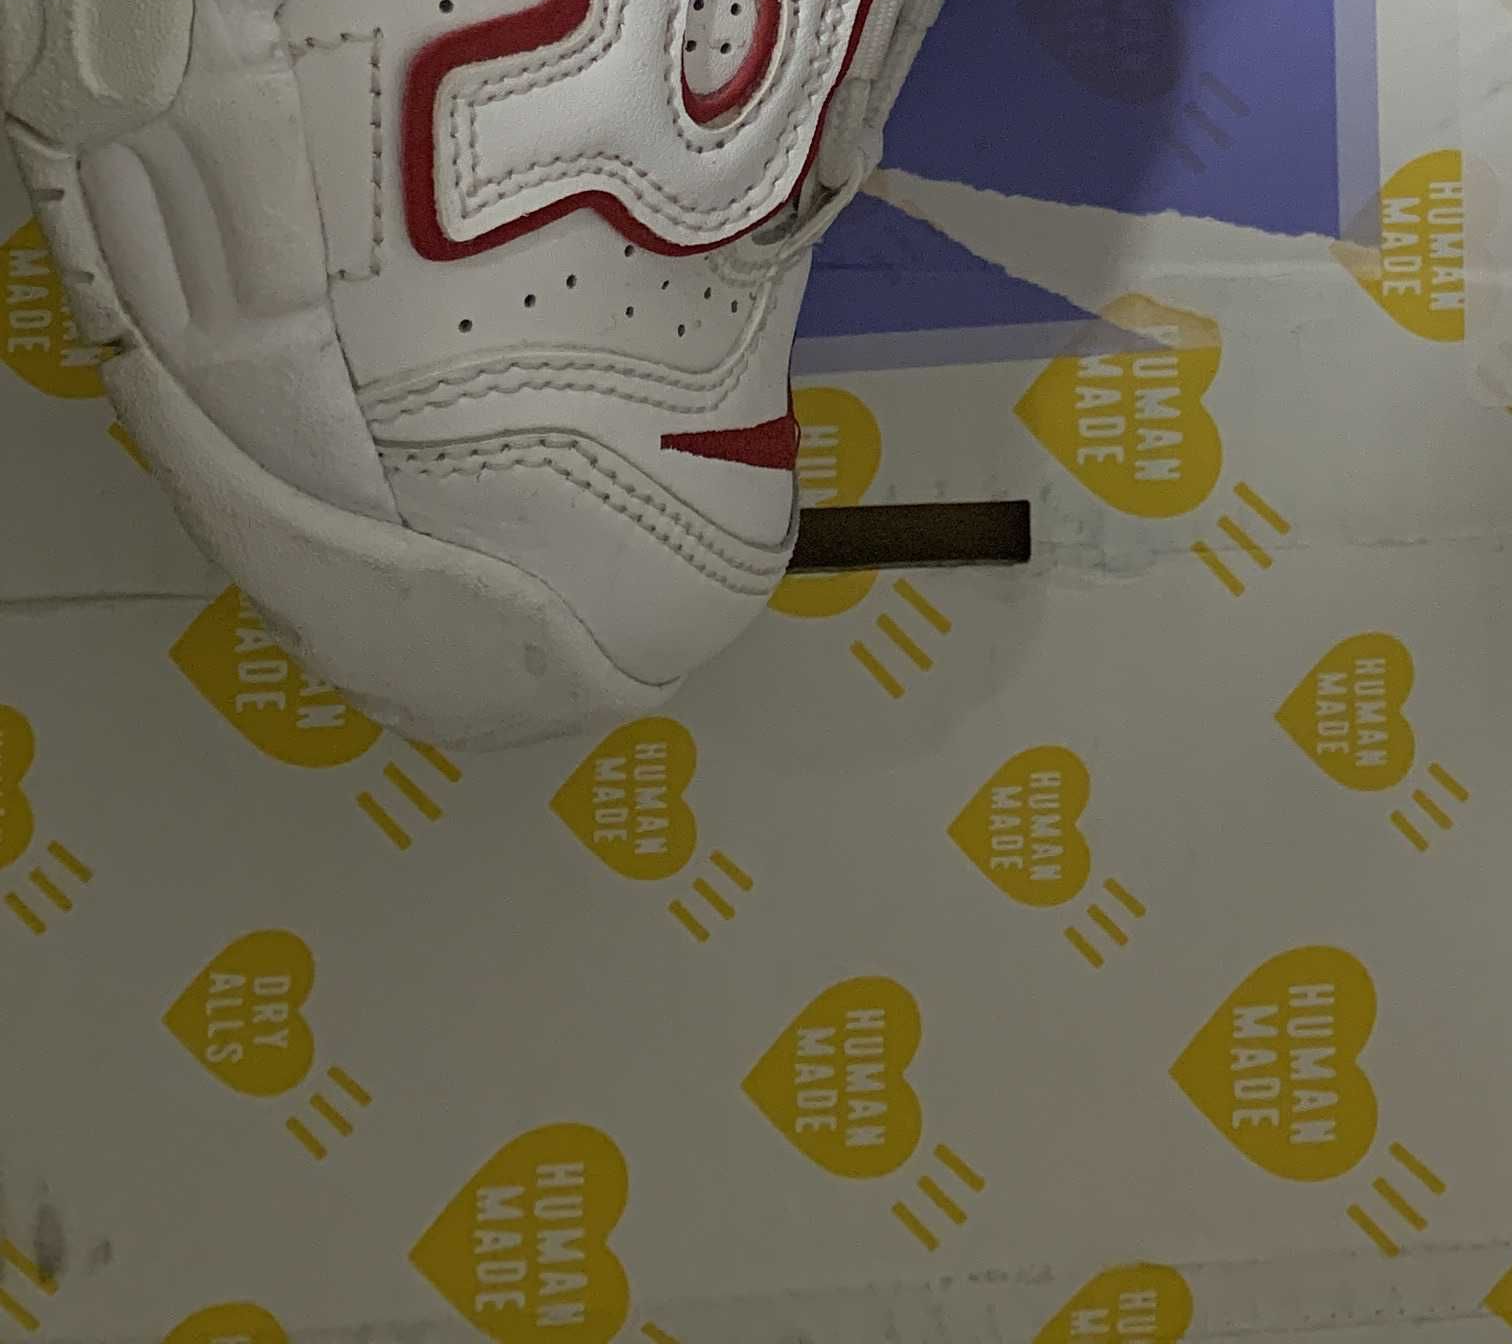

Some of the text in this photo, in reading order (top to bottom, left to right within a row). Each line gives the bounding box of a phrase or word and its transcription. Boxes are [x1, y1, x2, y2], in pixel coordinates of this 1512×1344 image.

[1381, 196, 1423, 296] MADE
[1427, 180, 1464, 311] HUMAN
[6, 248, 53, 354] MADE
[1075, 354, 1126, 466] MADE
[1317, 672, 1349, 752] MADE
[1353, 658, 1386, 766] HUMAN
[594, 756, 628, 839] MADE
[634, 743, 667, 854] HUMAN
[991, 785, 1025, 867] MADE
[1029, 771, 1063, 882] HUMAN
[205, 971, 245, 1063] ALLS
[251, 975, 290, 1046] DRY
[1231, 1005, 1282, 1125] MADE
[1287, 984, 1337, 1143] HUMAN
[796, 1027, 838, 1130] MADE
[843, 1009, 887, 1147] HUMAN
[476, 1185, 528, 1311] MADE
[533, 1163, 587, 1327] HUMAN
